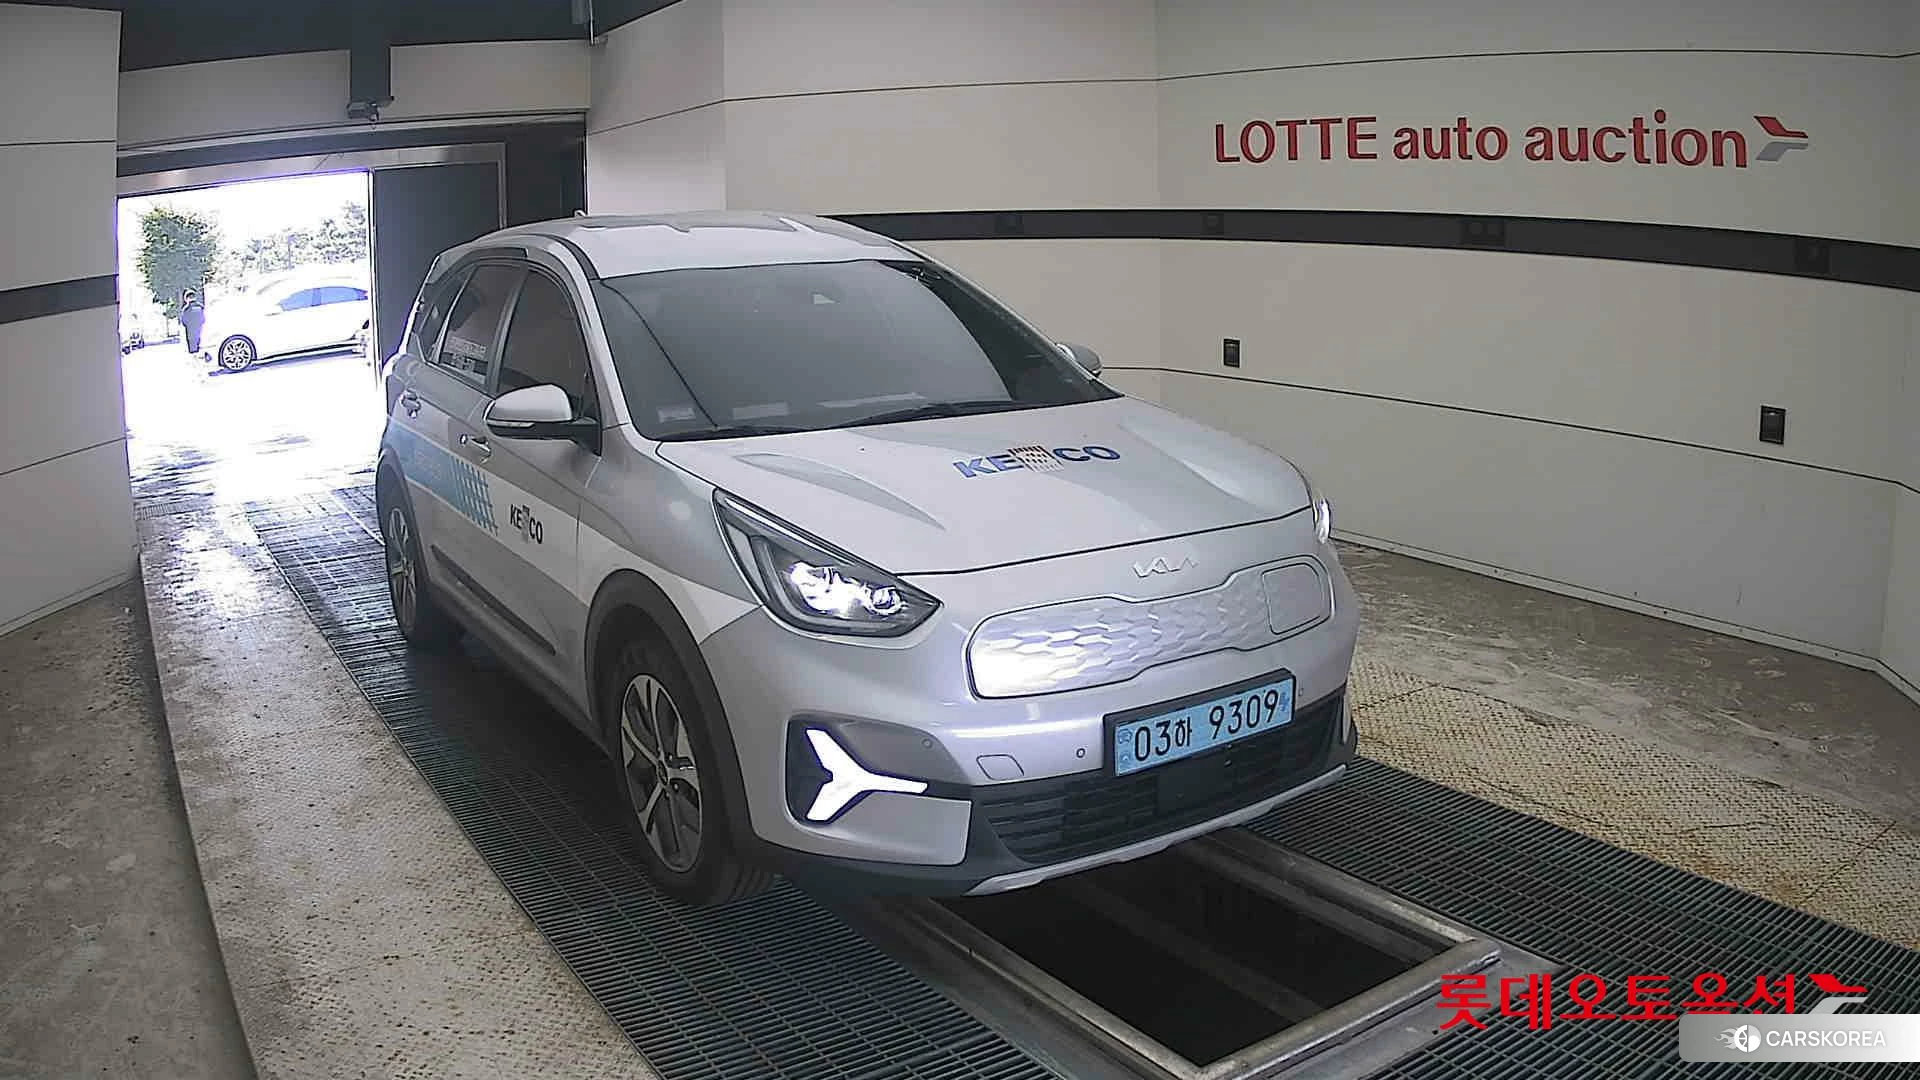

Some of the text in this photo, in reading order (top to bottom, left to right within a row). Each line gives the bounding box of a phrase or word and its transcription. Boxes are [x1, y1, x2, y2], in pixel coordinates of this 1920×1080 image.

[1214, 109, 1748, 168] LOTTE auto auction
[1134, 689, 1280, 762] 03하 9309
